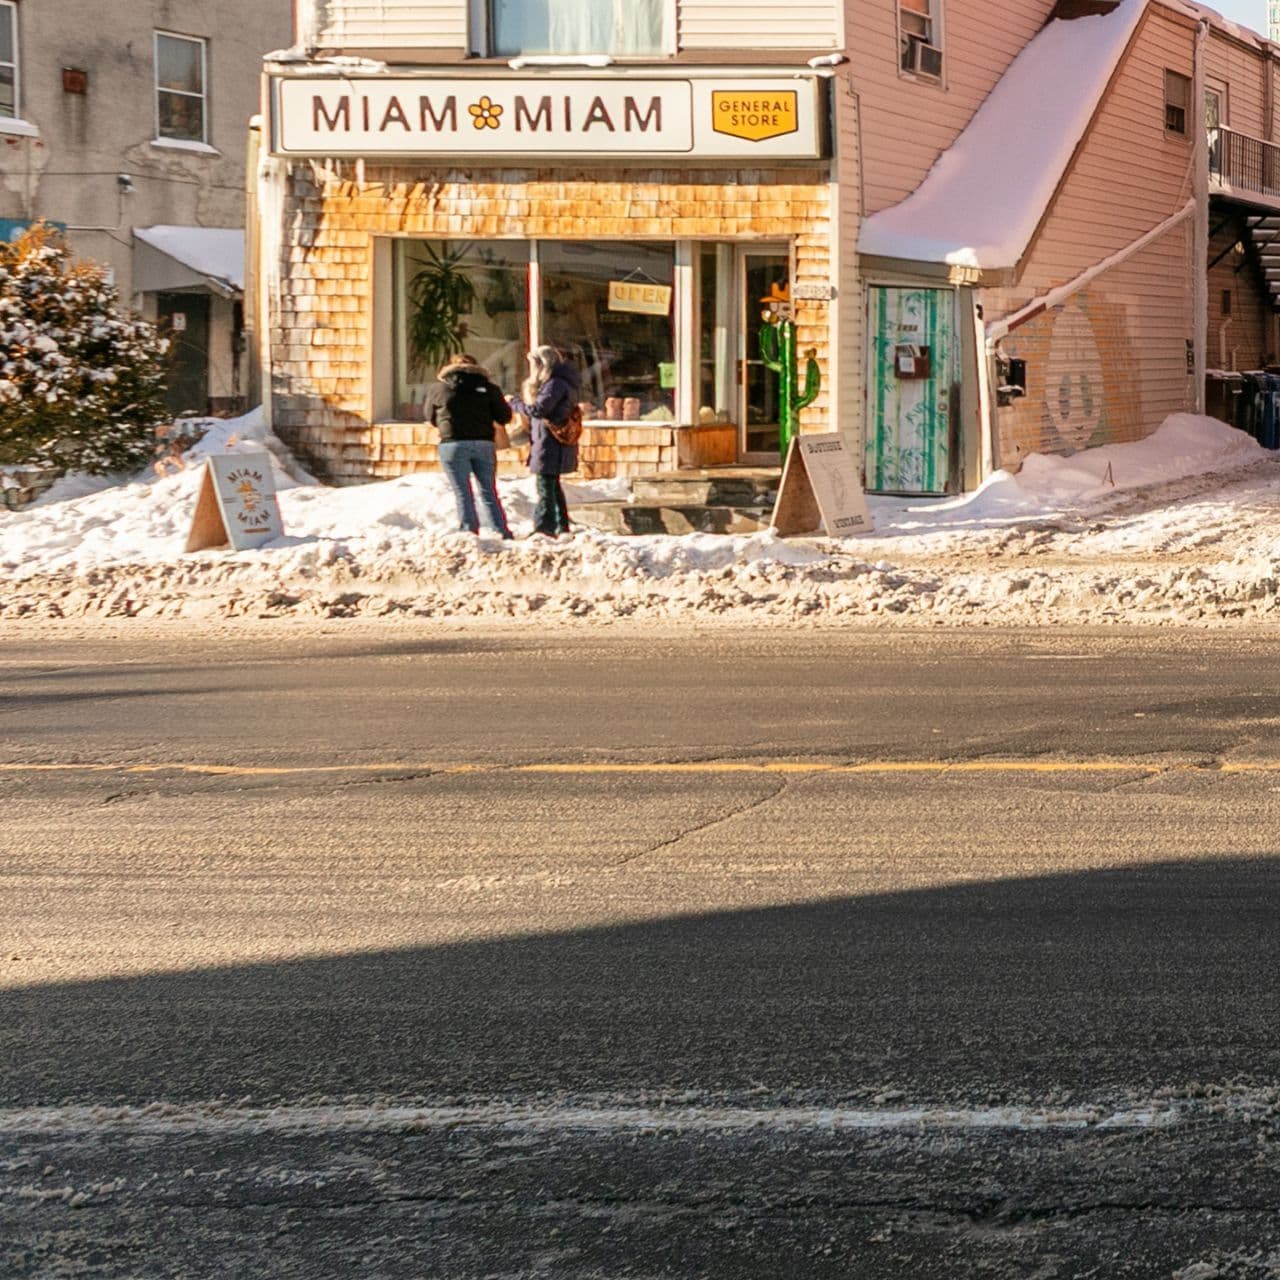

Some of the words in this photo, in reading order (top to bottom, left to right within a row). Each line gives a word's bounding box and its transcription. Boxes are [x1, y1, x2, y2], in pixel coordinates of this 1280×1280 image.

[312, 95, 458, 132] MIAM
[514, 95, 662, 132] MIAM
[719, 100, 791, 113] GENERAL
[731, 114, 779, 126] STORE
[615, 286, 668, 304] OPEN
[227, 468, 263, 483] MIAM
[237, 509, 271, 526] MIAM
